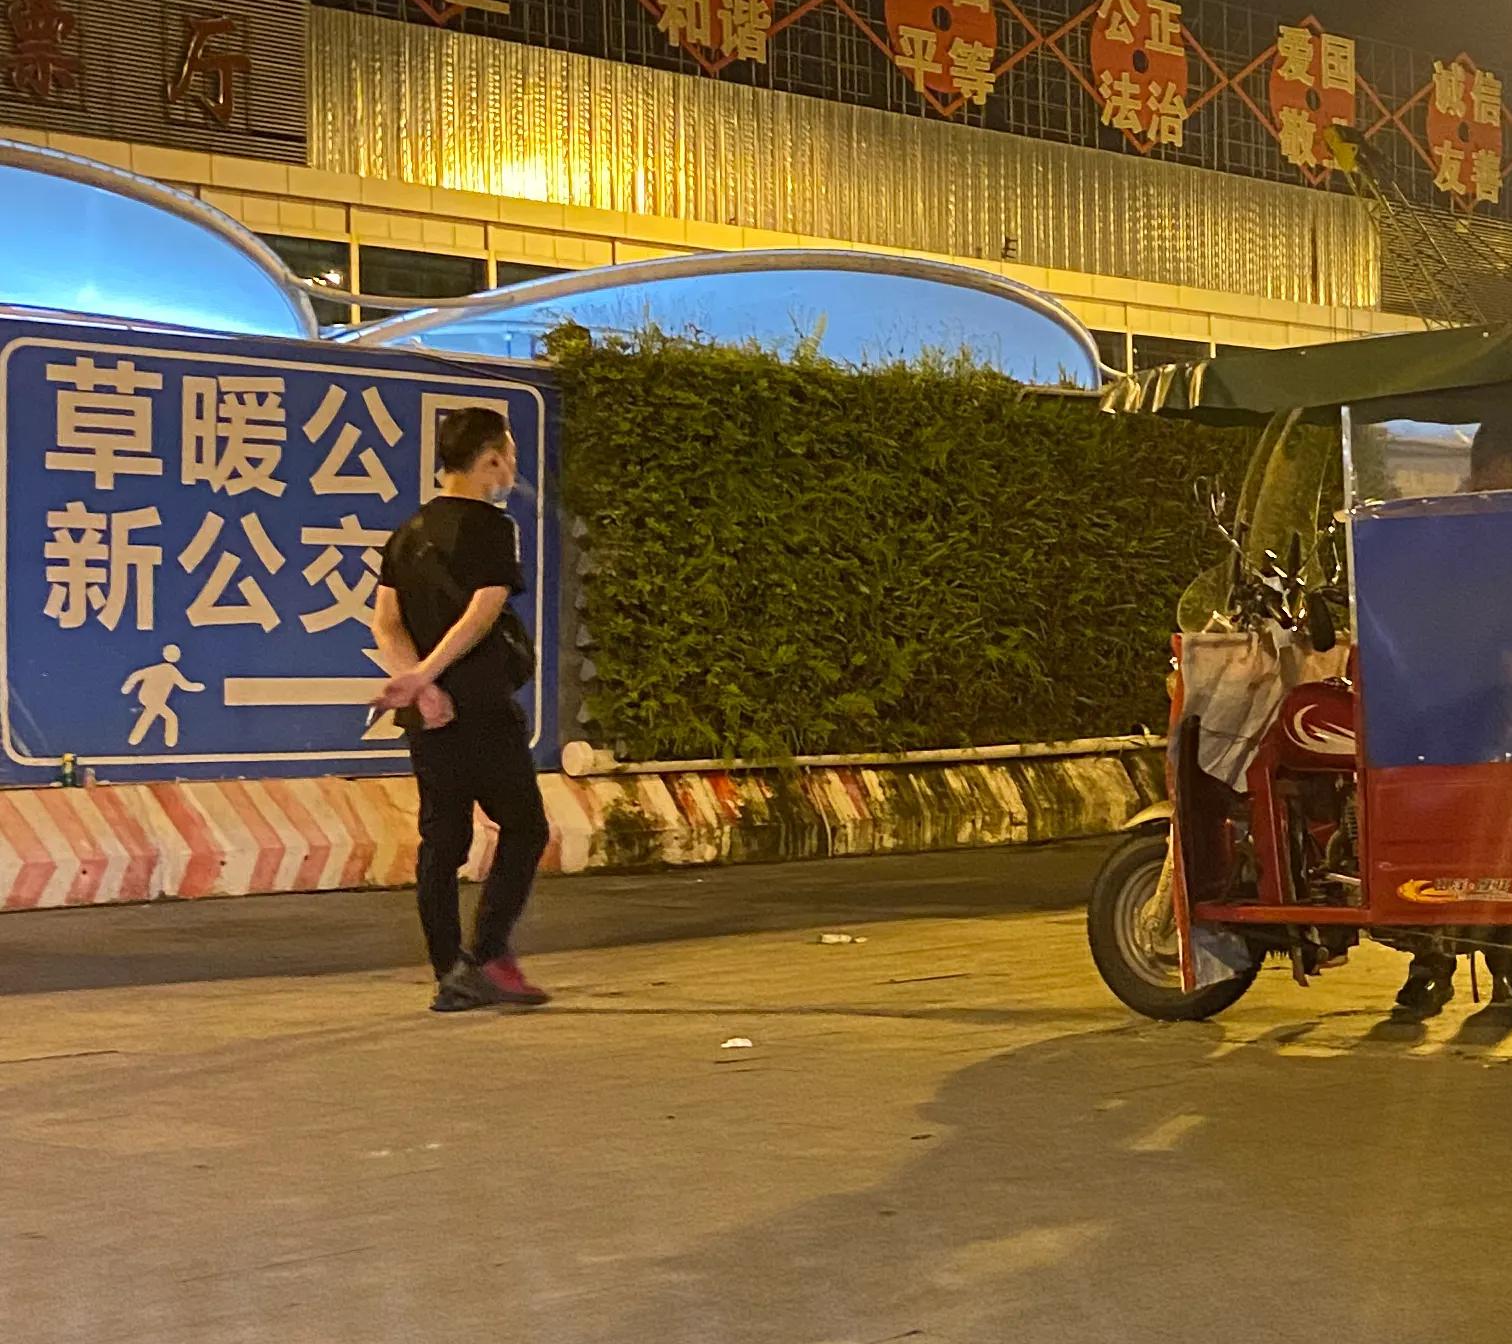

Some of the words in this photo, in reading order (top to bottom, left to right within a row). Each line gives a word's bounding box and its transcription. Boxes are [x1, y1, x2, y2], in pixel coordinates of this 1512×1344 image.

[896, 26, 996, 106] 平等
[1277, 25, 1356, 95] 爱国
[1432, 60, 1503, 128] 诚信
[1099, 70, 1188, 148] 法治
[1434, 140, 1502, 204] 友善
[43, 502, 394, 635] 新公交
